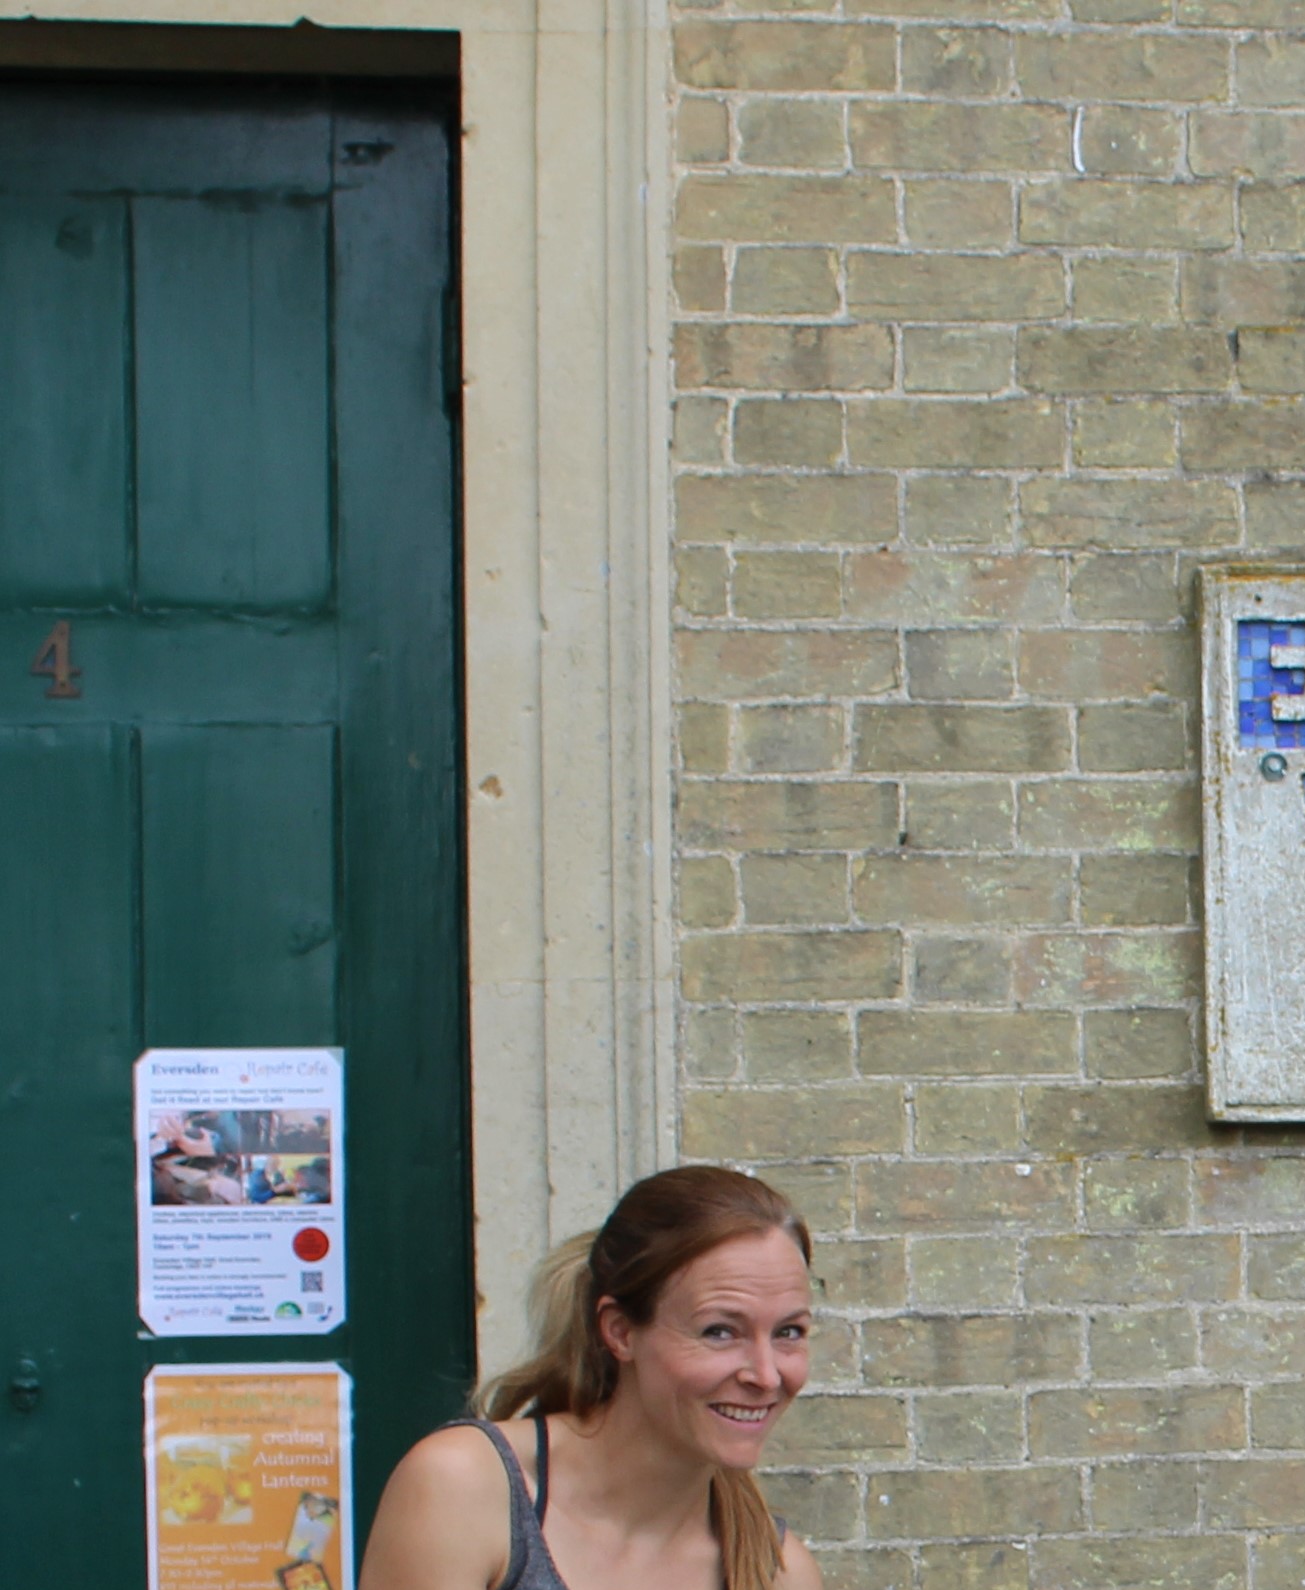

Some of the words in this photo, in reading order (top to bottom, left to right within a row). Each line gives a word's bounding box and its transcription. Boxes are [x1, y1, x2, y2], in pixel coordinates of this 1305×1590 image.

[30, 620, 83, 698] 4
[152, 1062, 218, 1074] Eversden
[262, 1430, 325, 1447] creating
[253, 1450, 335, 1466] Autumnal
[262, 1474, 328, 1488] Lanterns
